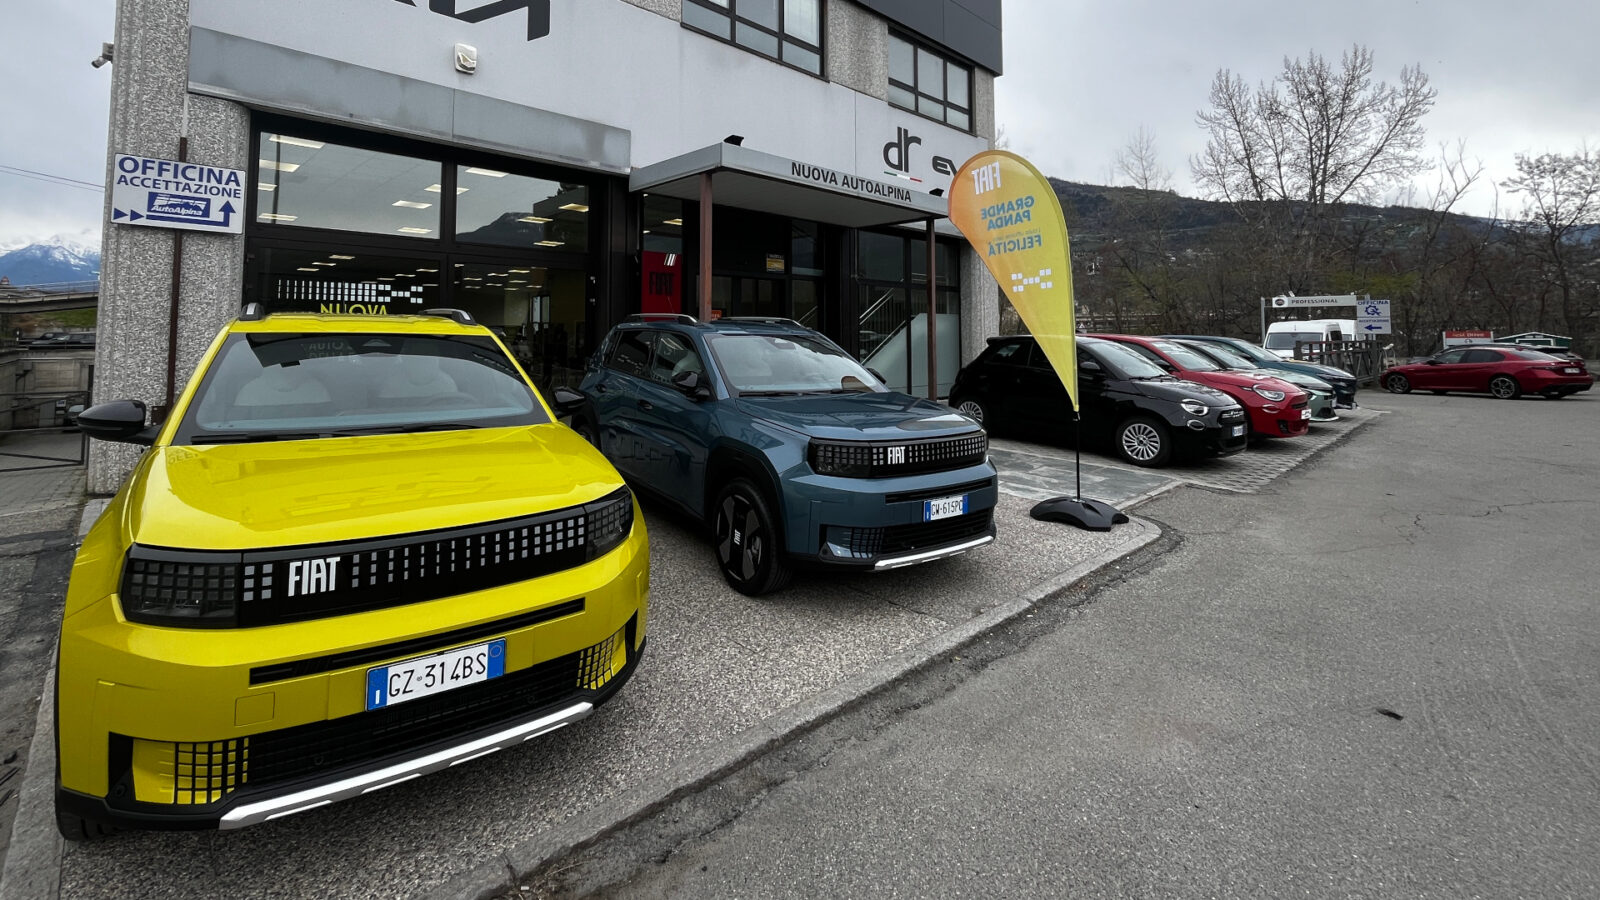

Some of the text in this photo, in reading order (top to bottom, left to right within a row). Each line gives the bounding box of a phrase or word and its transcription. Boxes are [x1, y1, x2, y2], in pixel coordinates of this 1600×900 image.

[118, 156, 241, 188] OFFICINA
[791, 161, 912, 203] NUOVA AUTOALPINA
[116, 174, 242, 199] ACCETTAZIONE
[150, 204, 203, 217] AutoAlpina
[887, 446, 906, 465] FIAT
[287, 556, 341, 597] FIAT
